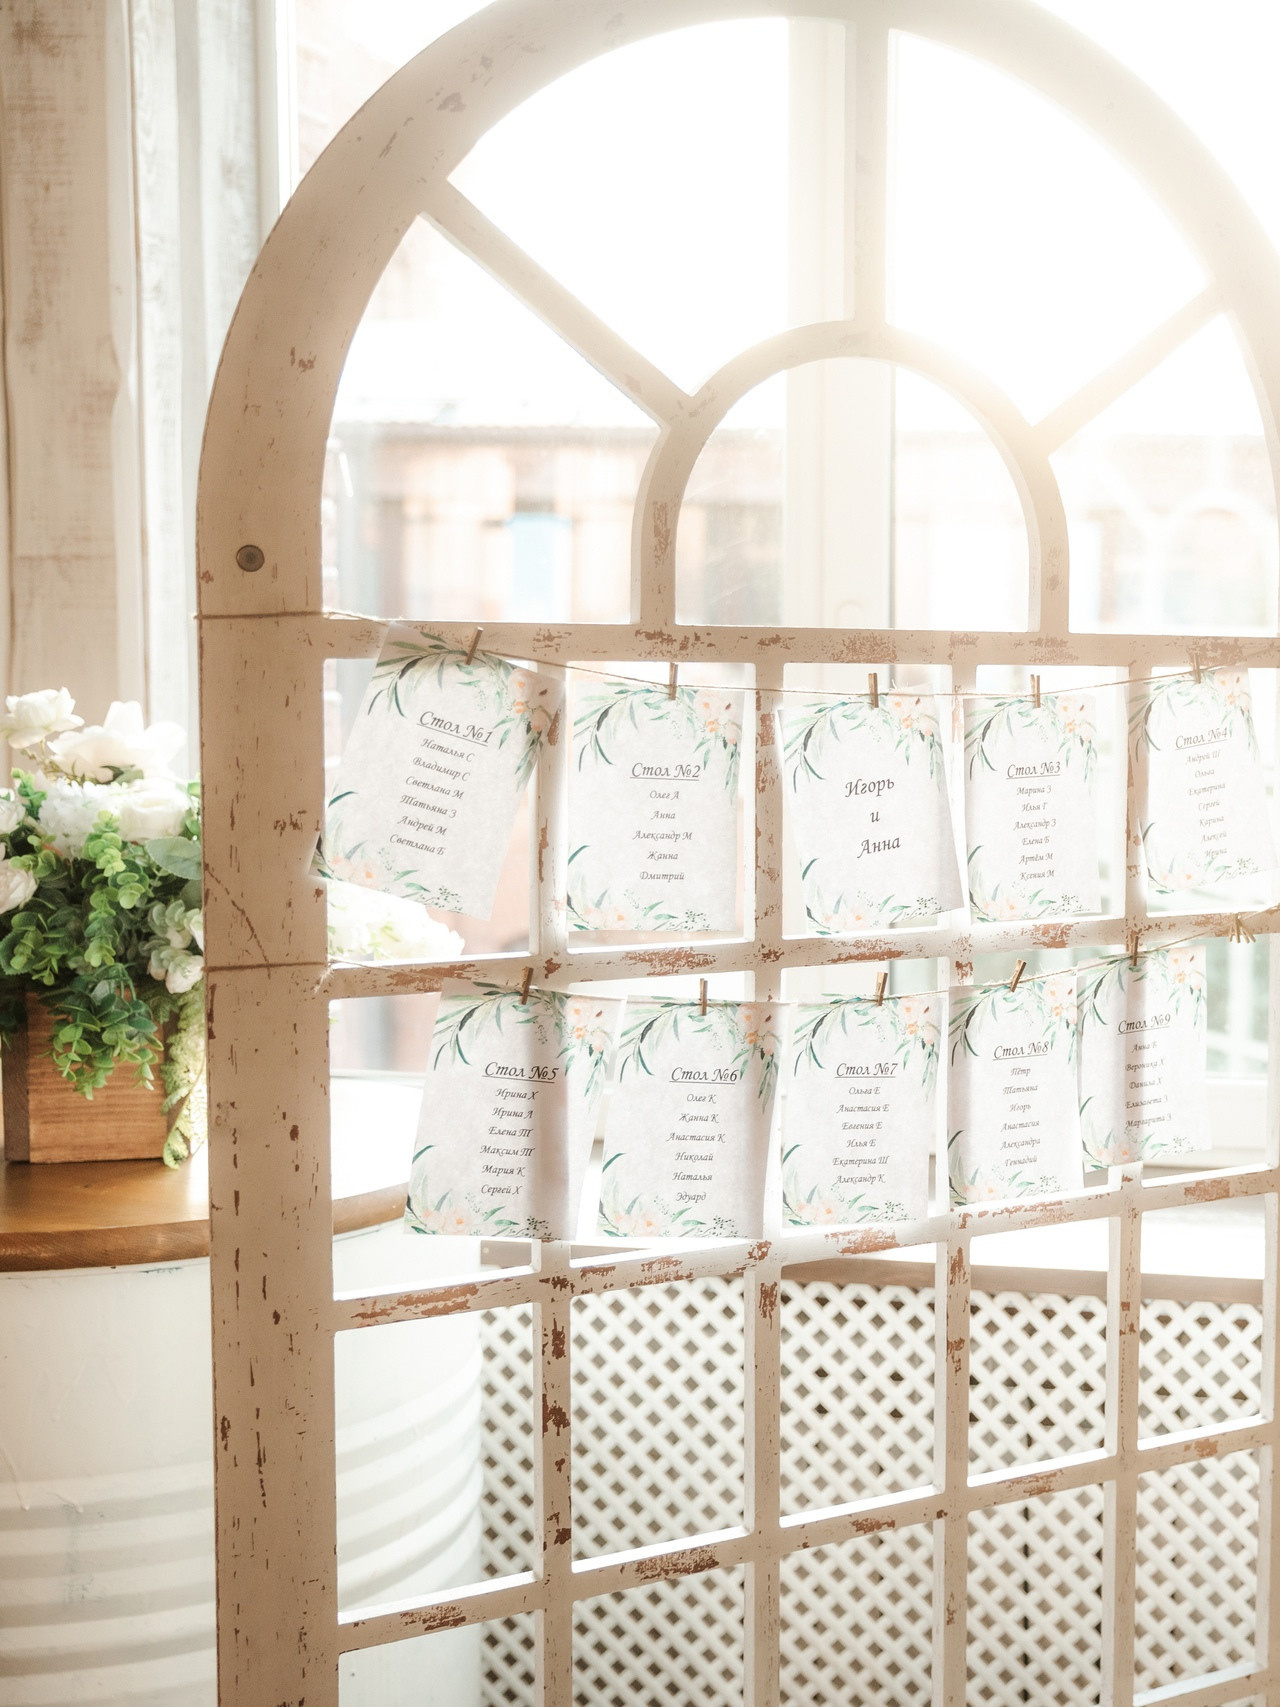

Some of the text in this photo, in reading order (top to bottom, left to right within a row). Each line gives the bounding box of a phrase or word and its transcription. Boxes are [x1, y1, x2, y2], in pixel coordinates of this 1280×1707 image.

[419, 710, 493, 743] Стол №1
[1175, 727, 1228, 749] Стол №4
[421, 738, 475, 762] Наталья С
[413, 757, 470, 781] Владимир С
[632, 763, 700, 778] Стол №2
[1007, 761, 1060, 778] Стол №3
[406, 776, 464, 800] Светлана М
[845, 779, 895, 797] Игорь
[1017, 787, 1045, 797] Марина
[649, 790, 680, 800] Олег А
[400, 795, 448, 815] Татьяна
[1022, 803, 1041, 812] Илья
[651, 810, 675, 820] Анна
[870, 811, 880, 822] и
[397, 815, 447, 835] Андрей М
[1013, 819, 1050, 831] Александр
[633, 830, 692, 842] Александр М
[1022, 837, 1043, 846] Елена
[390, 834, 446, 856] Светлана Б
[857, 837, 901, 858] Анна
[647, 851, 678, 861] Жанна
[640, 871, 685, 883] Дмитрий
[1020, 870, 1055, 881] Ксения М
[1118, 1013, 1171, 1034] Стол №9
[994, 1041, 1049, 1059] Стол №8
[485, 1062, 559, 1080] Стол №5
[671, 1067, 739, 1082] Стол №6
[836, 1062, 898, 1076] Стол №7
[496, 1088, 539, 1100] Ирина Х
[849, 1087, 880, 1095] Ольга Е
[1003, 1085, 1038, 1095] Татьяна
[686, 1094, 716, 1104] Олег К
[492, 1107, 523, 1119] Ирина
[836, 1104, 890, 1113] Анастасия Е
[1009, 1103, 1031, 1113] Игорь
[679, 1113, 719, 1124] Жанна К
[488, 1126, 517, 1137] Елена
[842, 1121, 883, 1130] Евгения Е
[1000, 1120, 1040, 1132] Анастасия
[666, 1132, 726, 1143] Анастасия К
[846, 1139, 876, 1148] Илья Е
[480, 1145, 519, 1157] Максим
[675, 1152, 714, 1163] Николай
[833, 1157, 877, 1167] Екатерина
[482, 1165, 526, 1177] Мария К
[672, 1172, 712, 1181] Наталья
[834, 1173, 885, 1185] Александр К
[481, 1184, 522, 1196] Сергей Х
[676, 1192, 706, 1203] Эдуард
